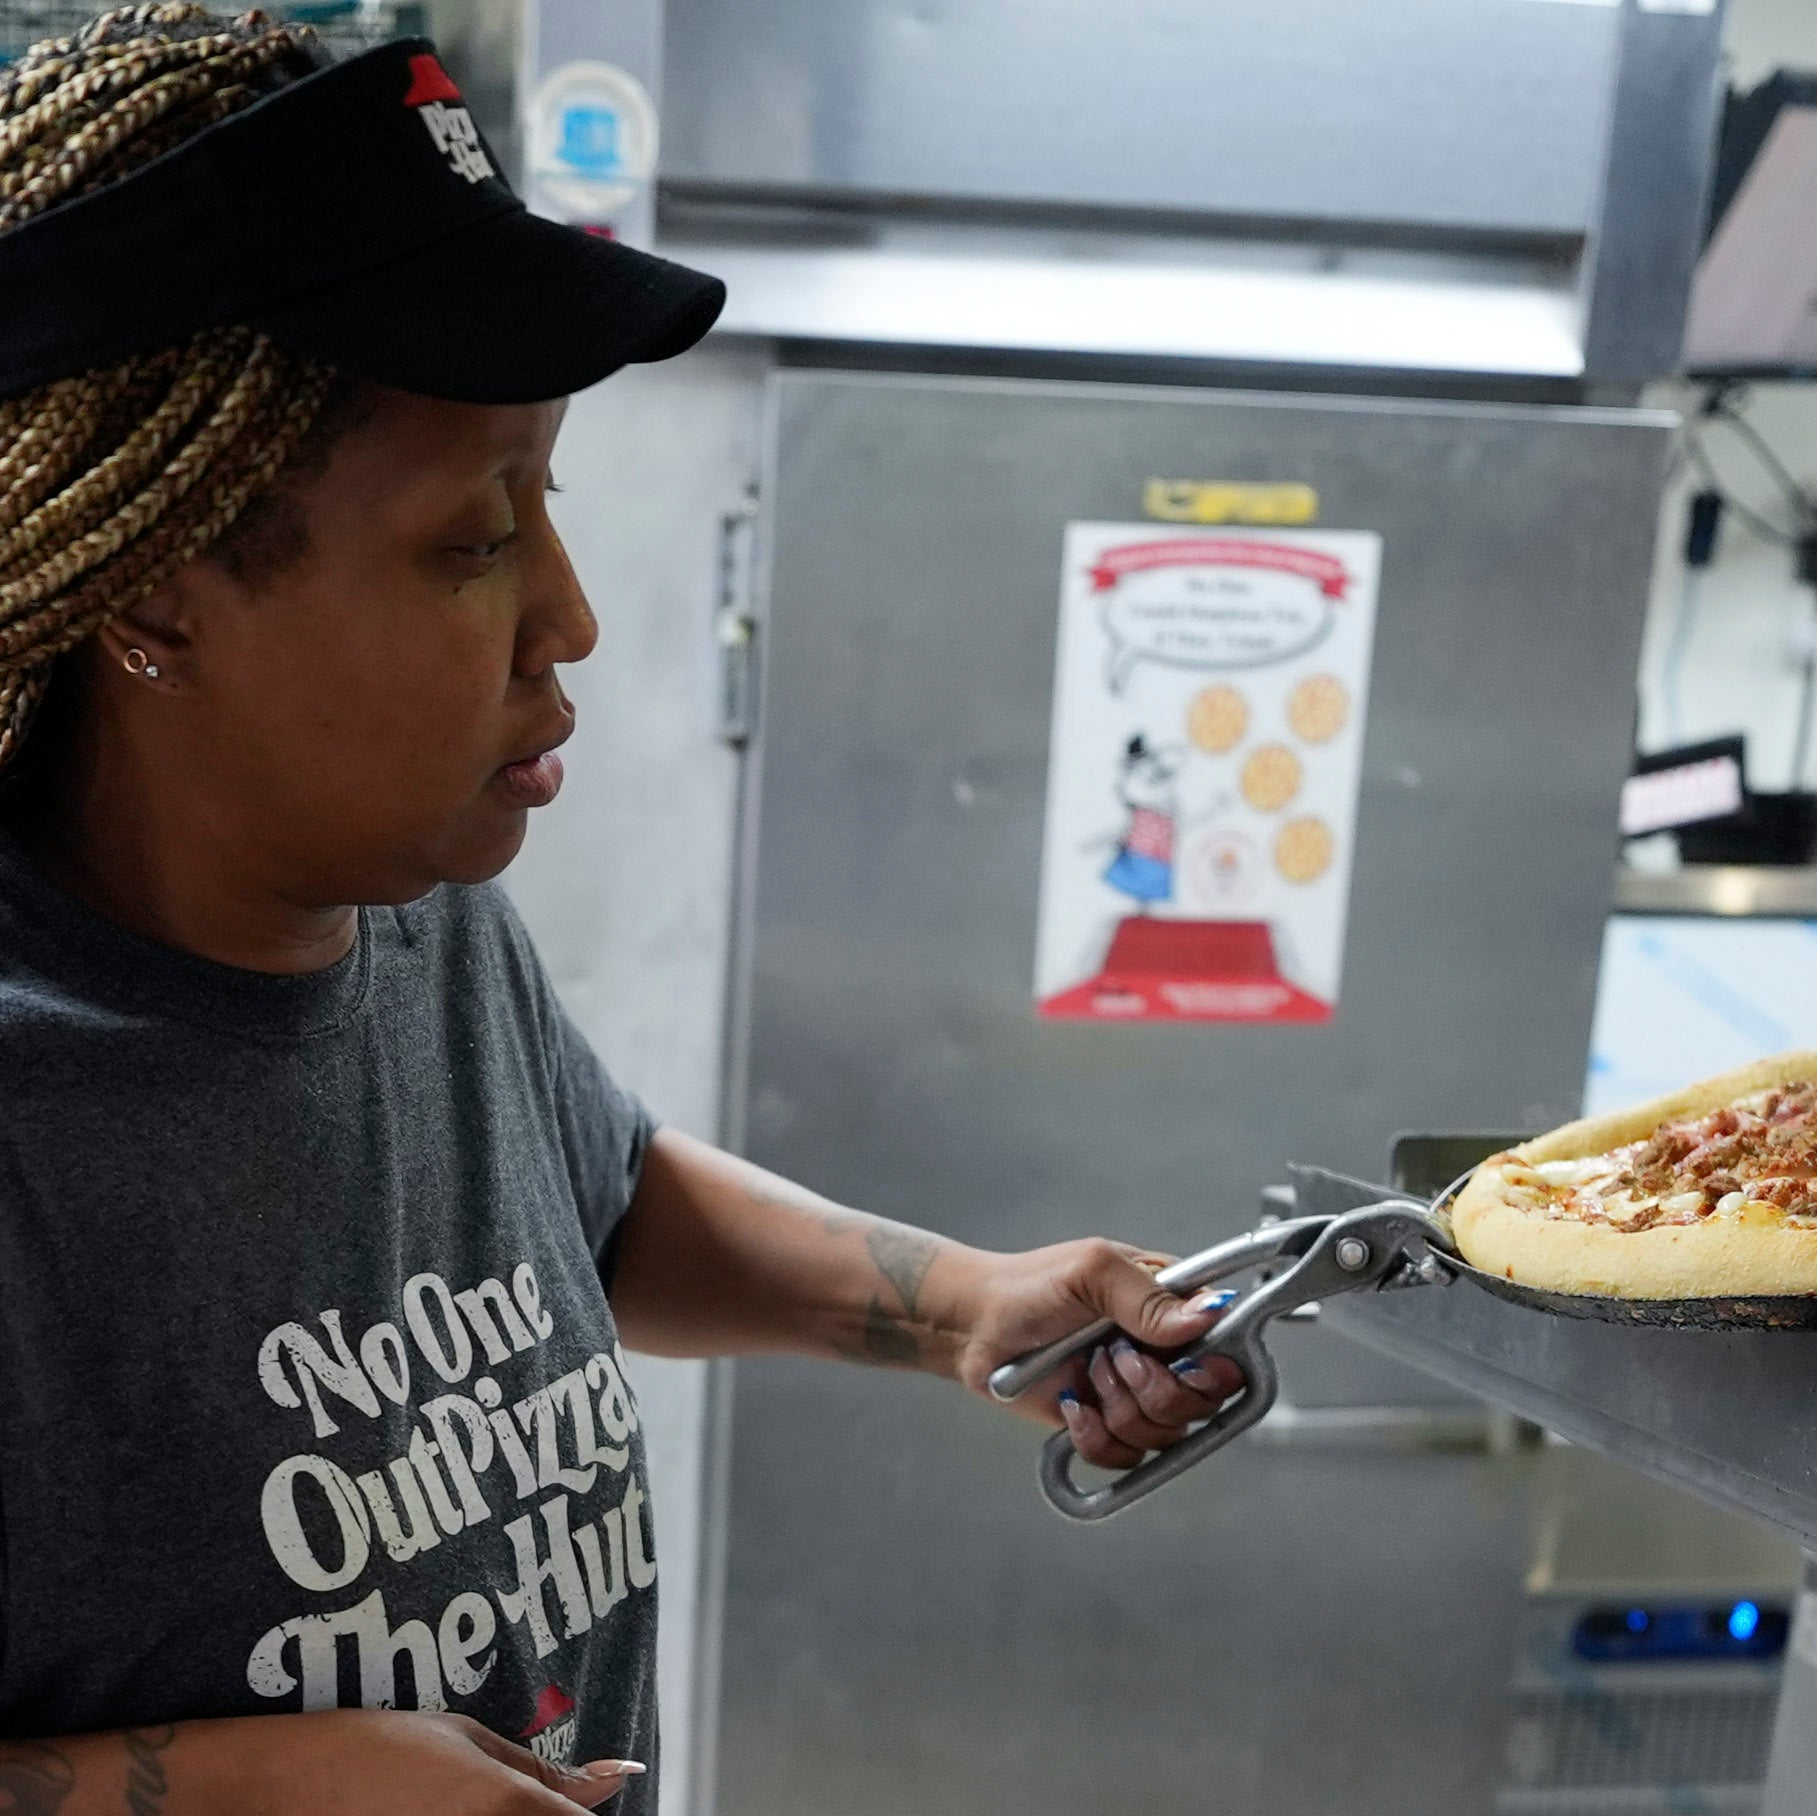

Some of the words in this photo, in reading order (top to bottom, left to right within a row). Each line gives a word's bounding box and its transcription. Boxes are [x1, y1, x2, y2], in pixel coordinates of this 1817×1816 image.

[258, 1309, 410, 1438] No
[403, 1262, 554, 1384] One
[247, 1589, 498, 1713] The
[496, 1472, 657, 1660] Hut
